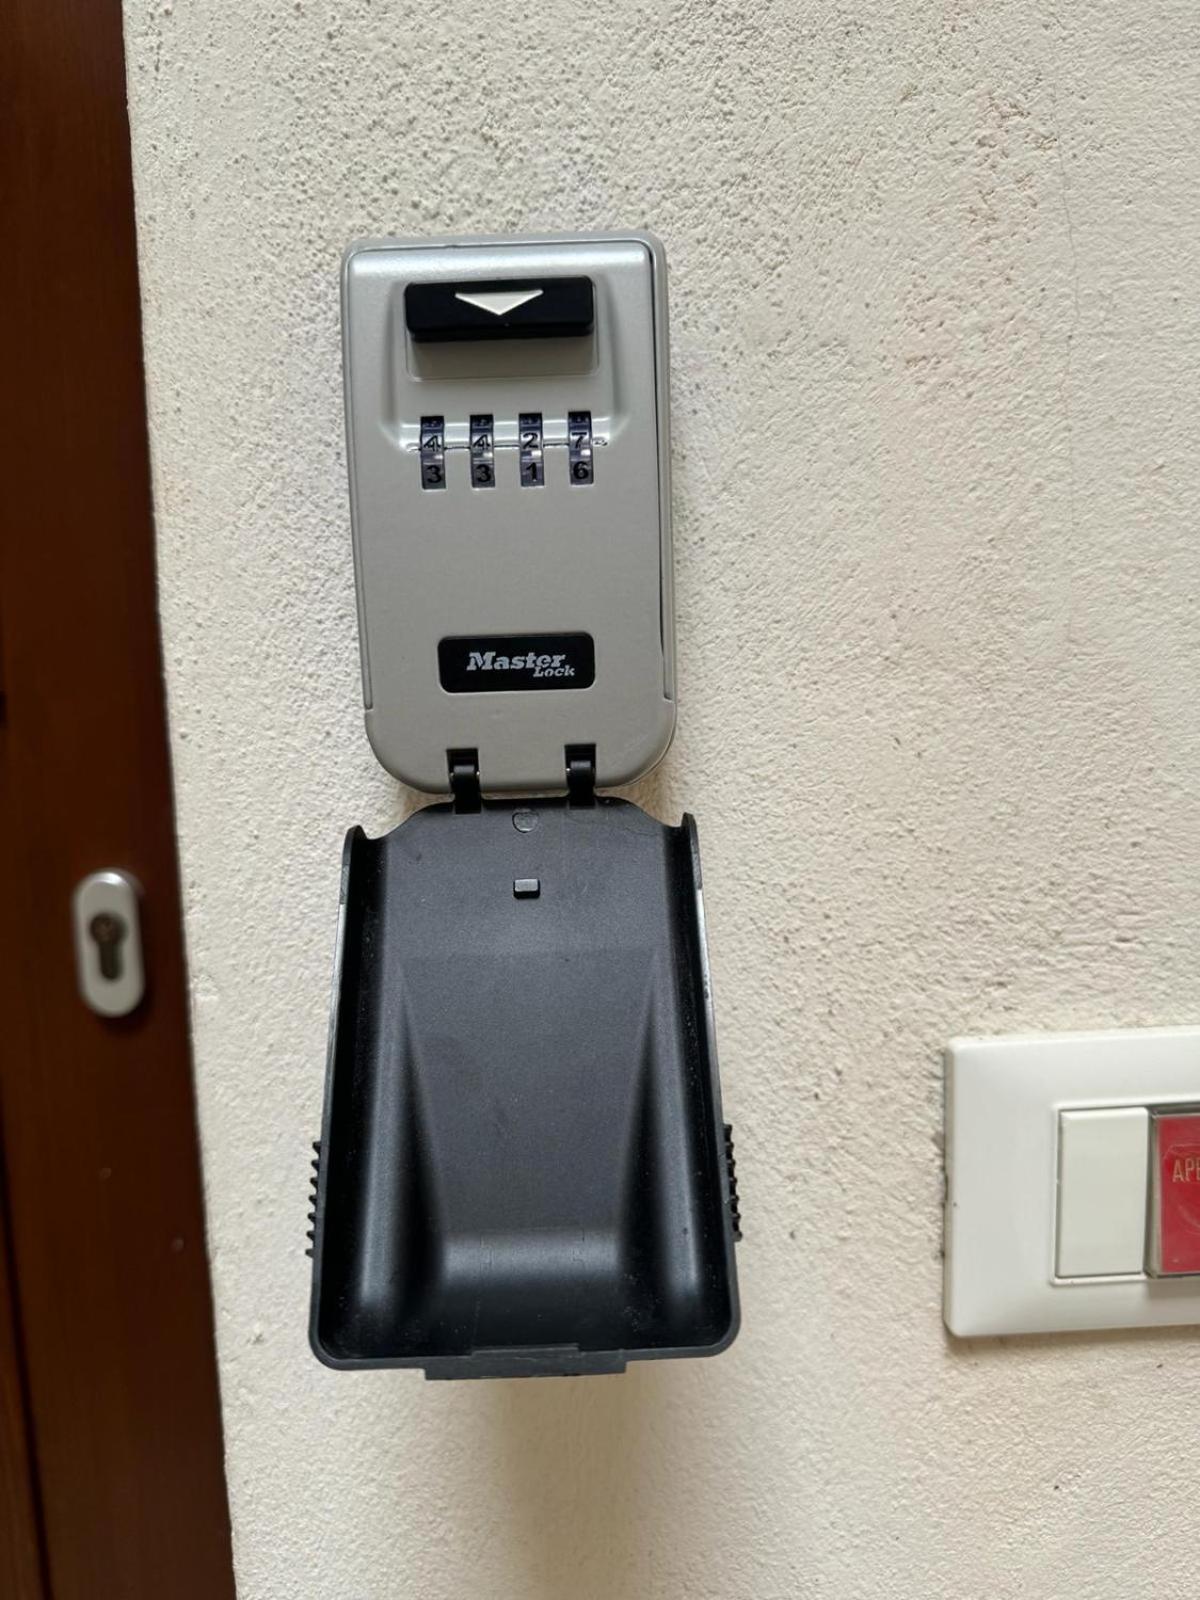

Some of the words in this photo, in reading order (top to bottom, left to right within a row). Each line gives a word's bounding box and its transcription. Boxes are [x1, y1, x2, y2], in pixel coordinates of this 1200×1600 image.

[423, 433, 442, 452] 4
[473, 433, 491, 452] 4
[522, 432, 539, 450] 2
[571, 431, 588, 448] 7
[427, 464, 443, 484] 3
[476, 463, 492, 483] 3
[526, 462, 538, 482] 1
[573, 461, 589, 480] 6
[466, 651, 566, 671] Master
[533, 665, 575, 678] Lock
